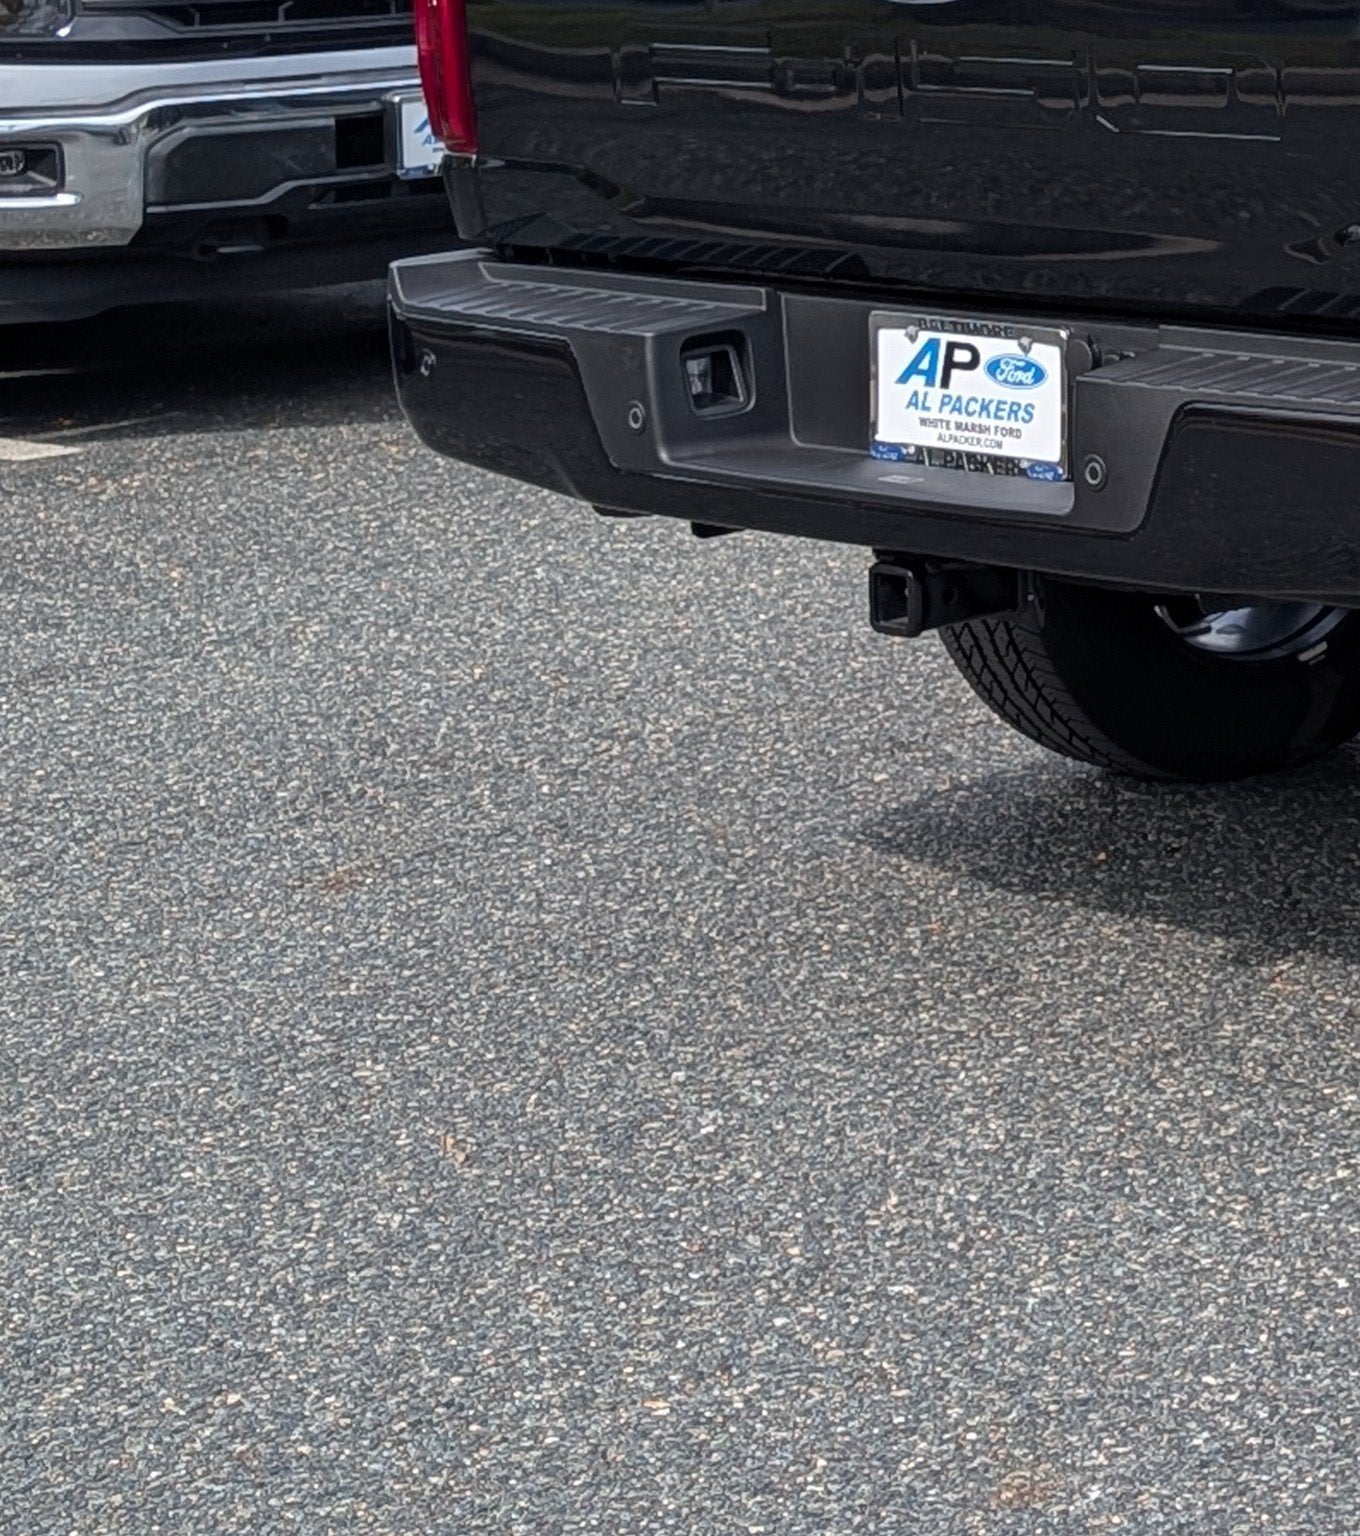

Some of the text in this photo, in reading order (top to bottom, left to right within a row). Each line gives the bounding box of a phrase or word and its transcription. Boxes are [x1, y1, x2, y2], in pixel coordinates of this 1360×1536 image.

[895, 337, 981, 390] AP
[993, 357, 1036, 386] Ford
[905, 390, 1036, 424] AL PACKERS
[918, 417, 1022, 439] WHITE MARSH FORD
